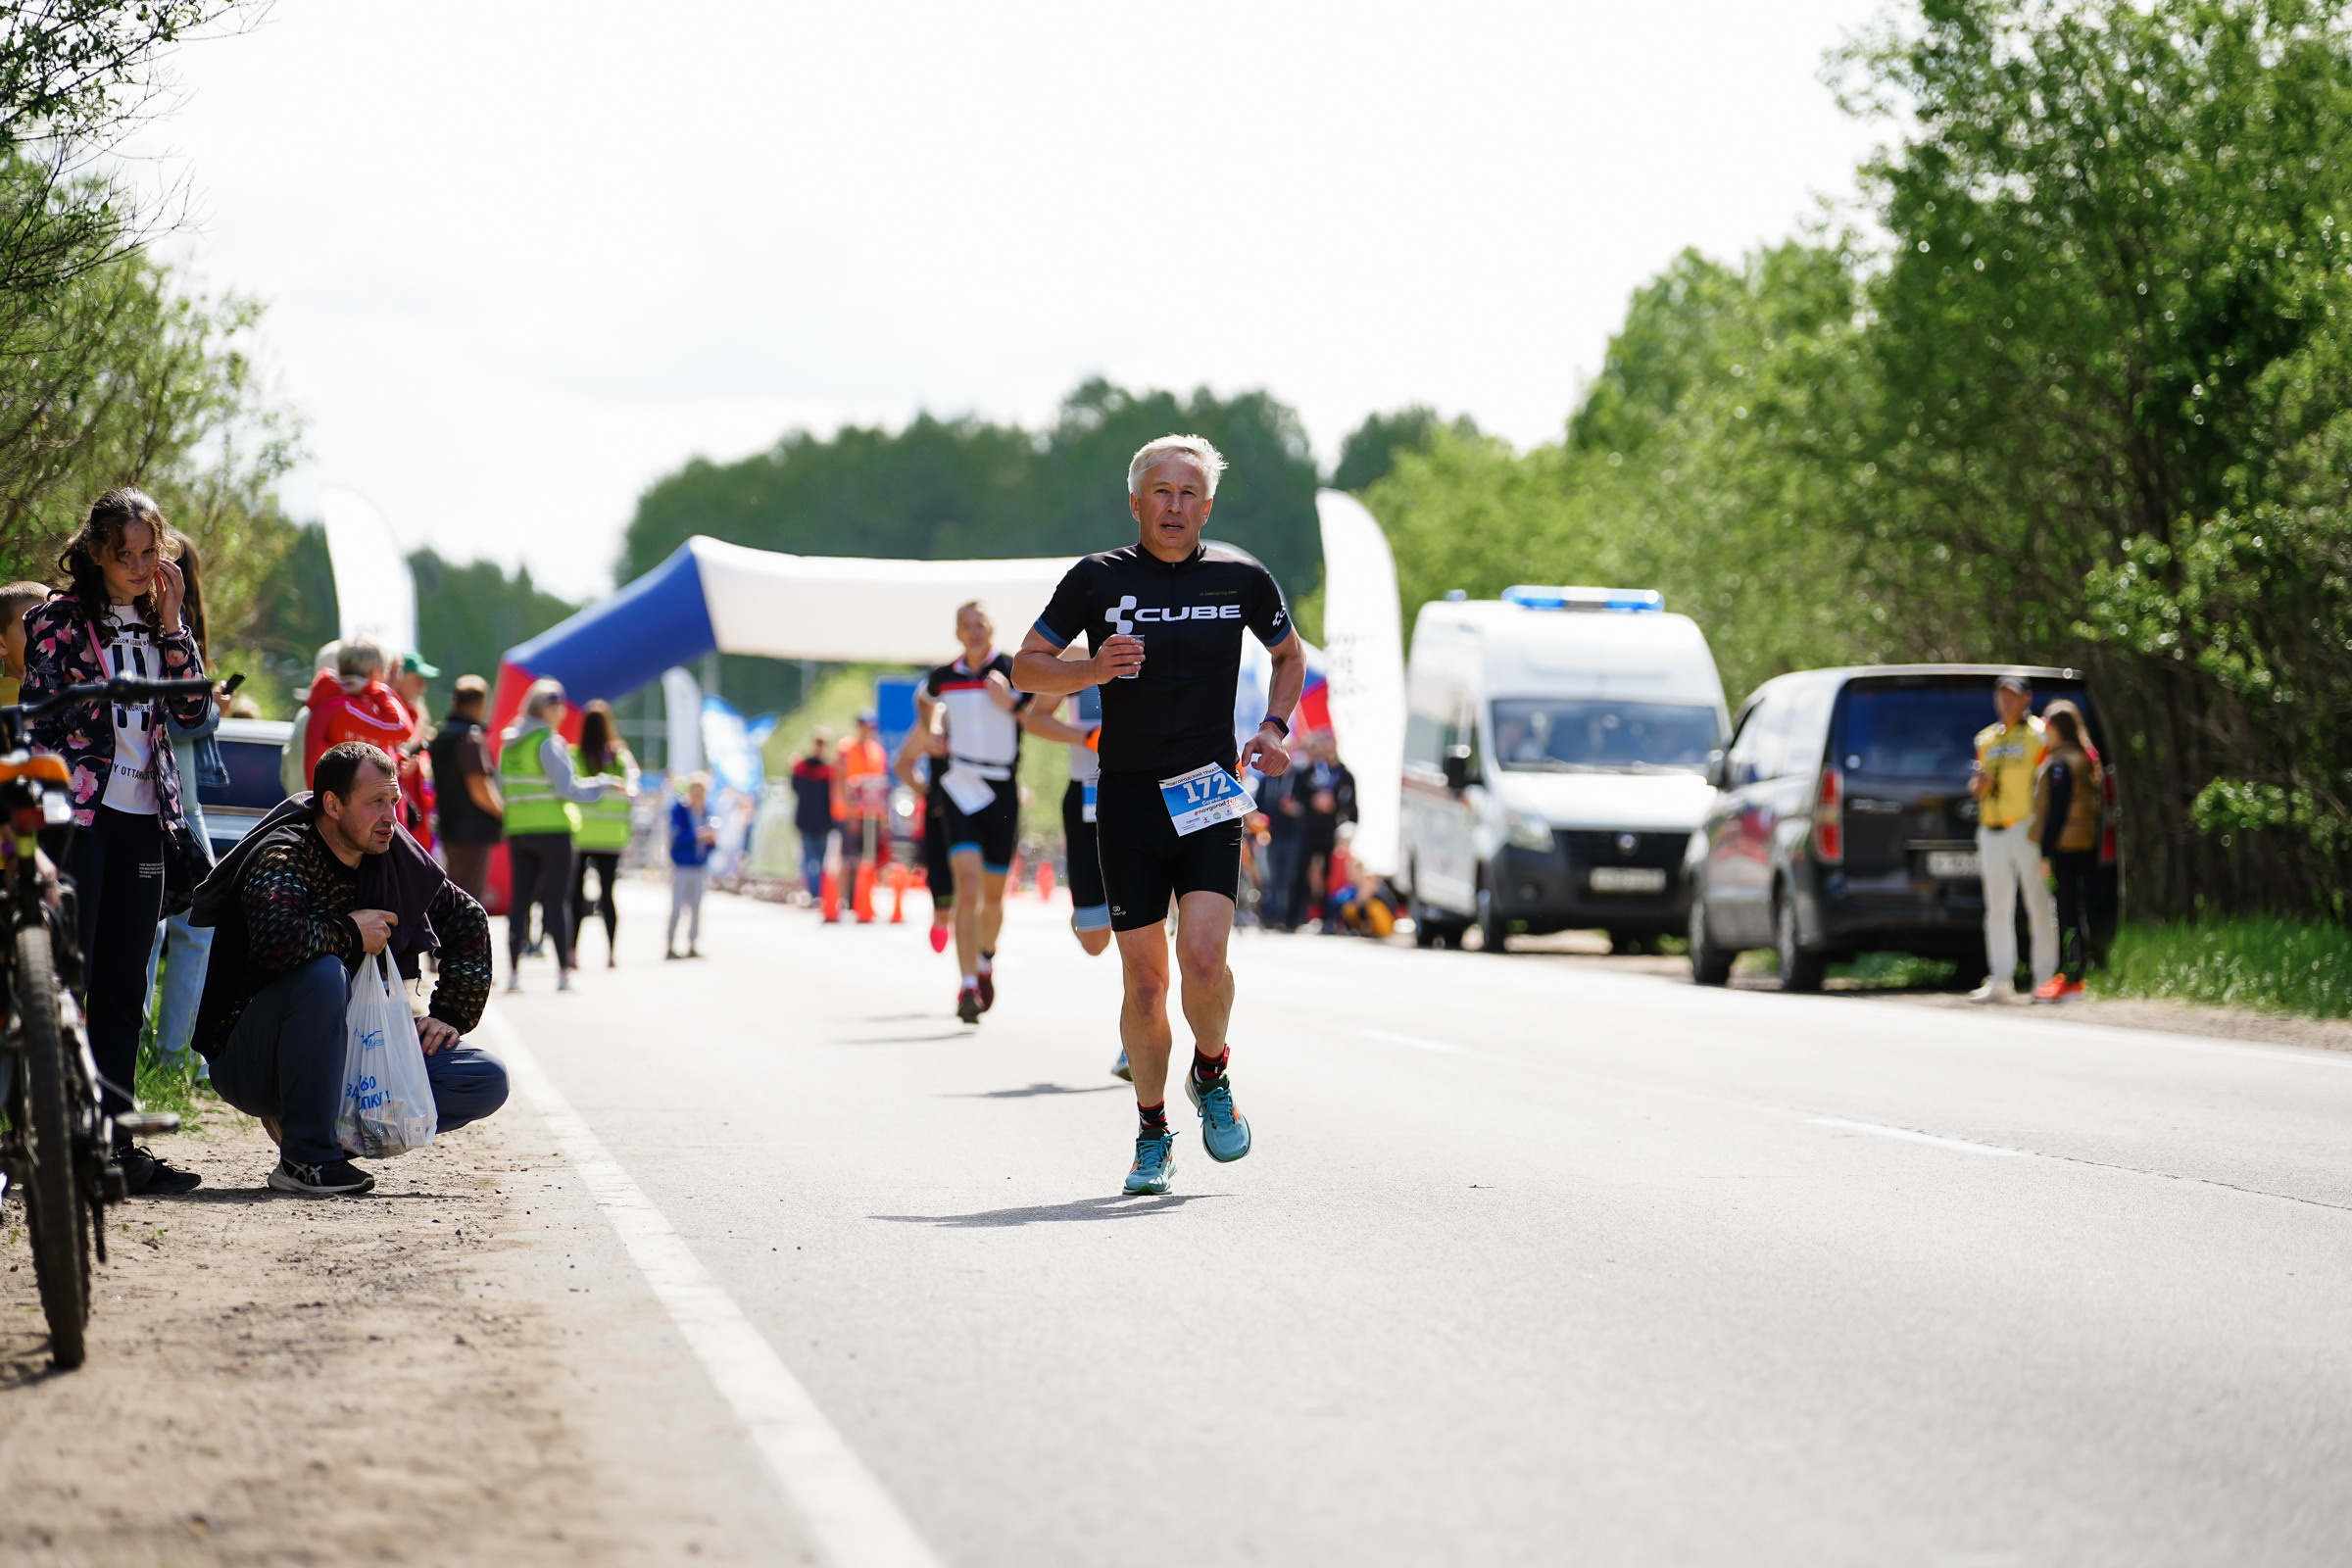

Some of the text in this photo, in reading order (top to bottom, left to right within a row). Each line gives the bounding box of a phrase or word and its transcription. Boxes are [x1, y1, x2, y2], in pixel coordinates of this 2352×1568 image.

[1134, 604, 1242, 622] CUBE
[1183, 773, 1231, 804] 172
[1201, 796, 1221, 806] Сергей
